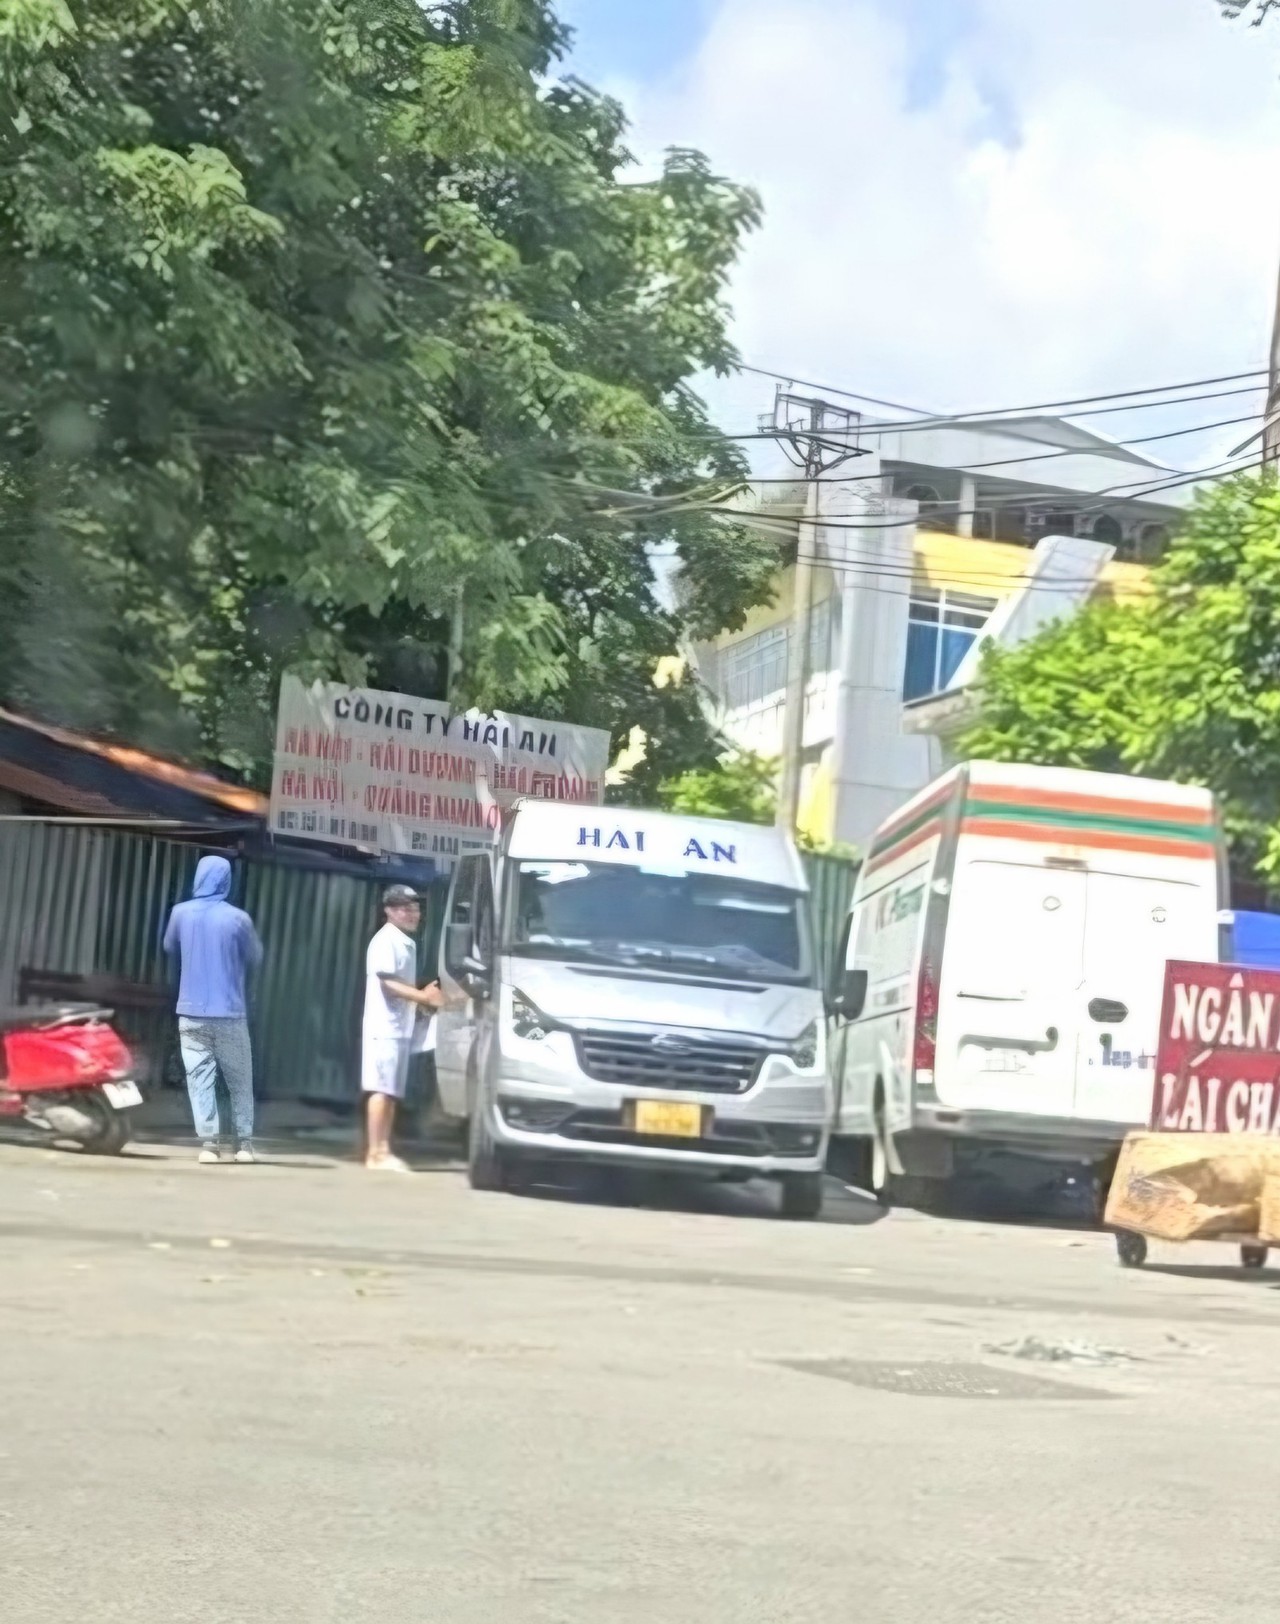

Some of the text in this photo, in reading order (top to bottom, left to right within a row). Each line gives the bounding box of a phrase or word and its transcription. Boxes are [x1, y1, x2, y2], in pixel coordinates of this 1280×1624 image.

[423, 712, 451, 737] TY
[518, 730, 557, 757] AN
[683, 838, 738, 863] AN
[1170, 972, 1274, 1049] NGÂN
